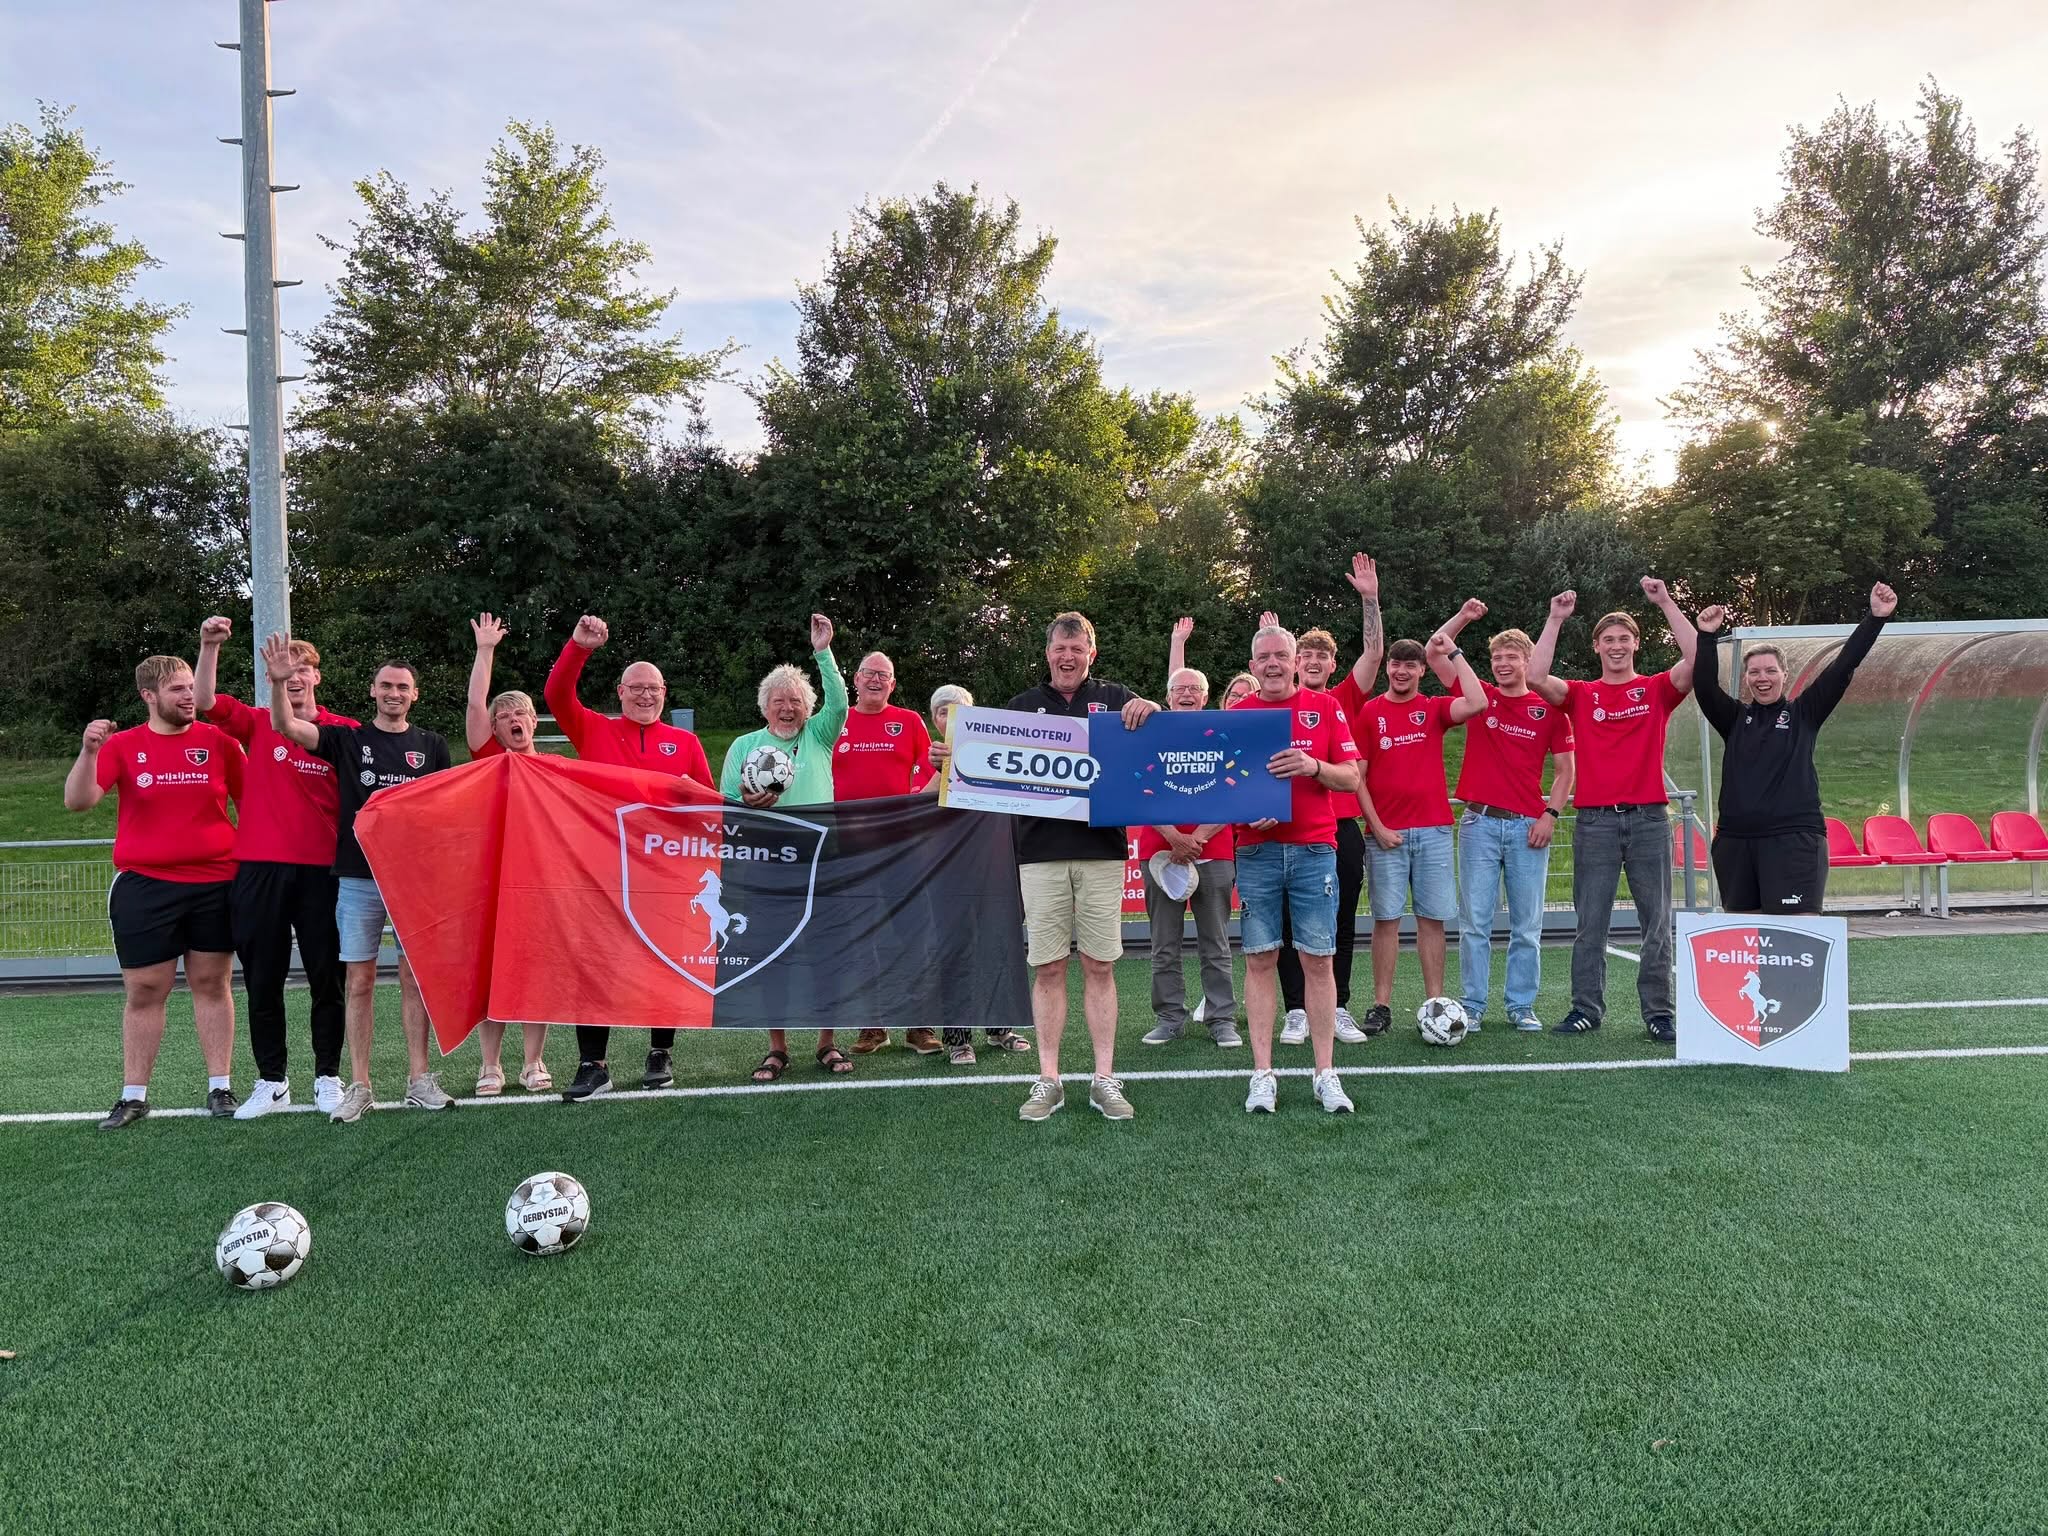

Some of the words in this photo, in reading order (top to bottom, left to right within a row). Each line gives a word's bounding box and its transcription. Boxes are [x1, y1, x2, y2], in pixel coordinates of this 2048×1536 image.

[965, 721, 1072, 743] VRIENDENLOTERIJ
[1157, 751, 1224, 763] VRIENDEN
[156, 771, 209, 781] wijzijntop
[1166, 762, 1216, 775] LOTERIJ
[1032, 785, 1065, 794] PELIKAAN
[1163, 780, 1178, 791] elke
[1178, 785, 1193, 795] dag
[1193, 778, 1217, 794] plezier
[644, 834, 798, 863] Pelikaan-S
[681, 955, 695, 964] 11
[698, 956, 719, 965] MEI
[723, 957, 750, 966] 1957
[1705, 948, 1814, 967] Pelikaan-S
[1764, 1026, 1783, 1034] 1957
[522, 1205, 569, 1224] DERBYSTAR
[223, 1228, 270, 1255] DERBYSTAR
